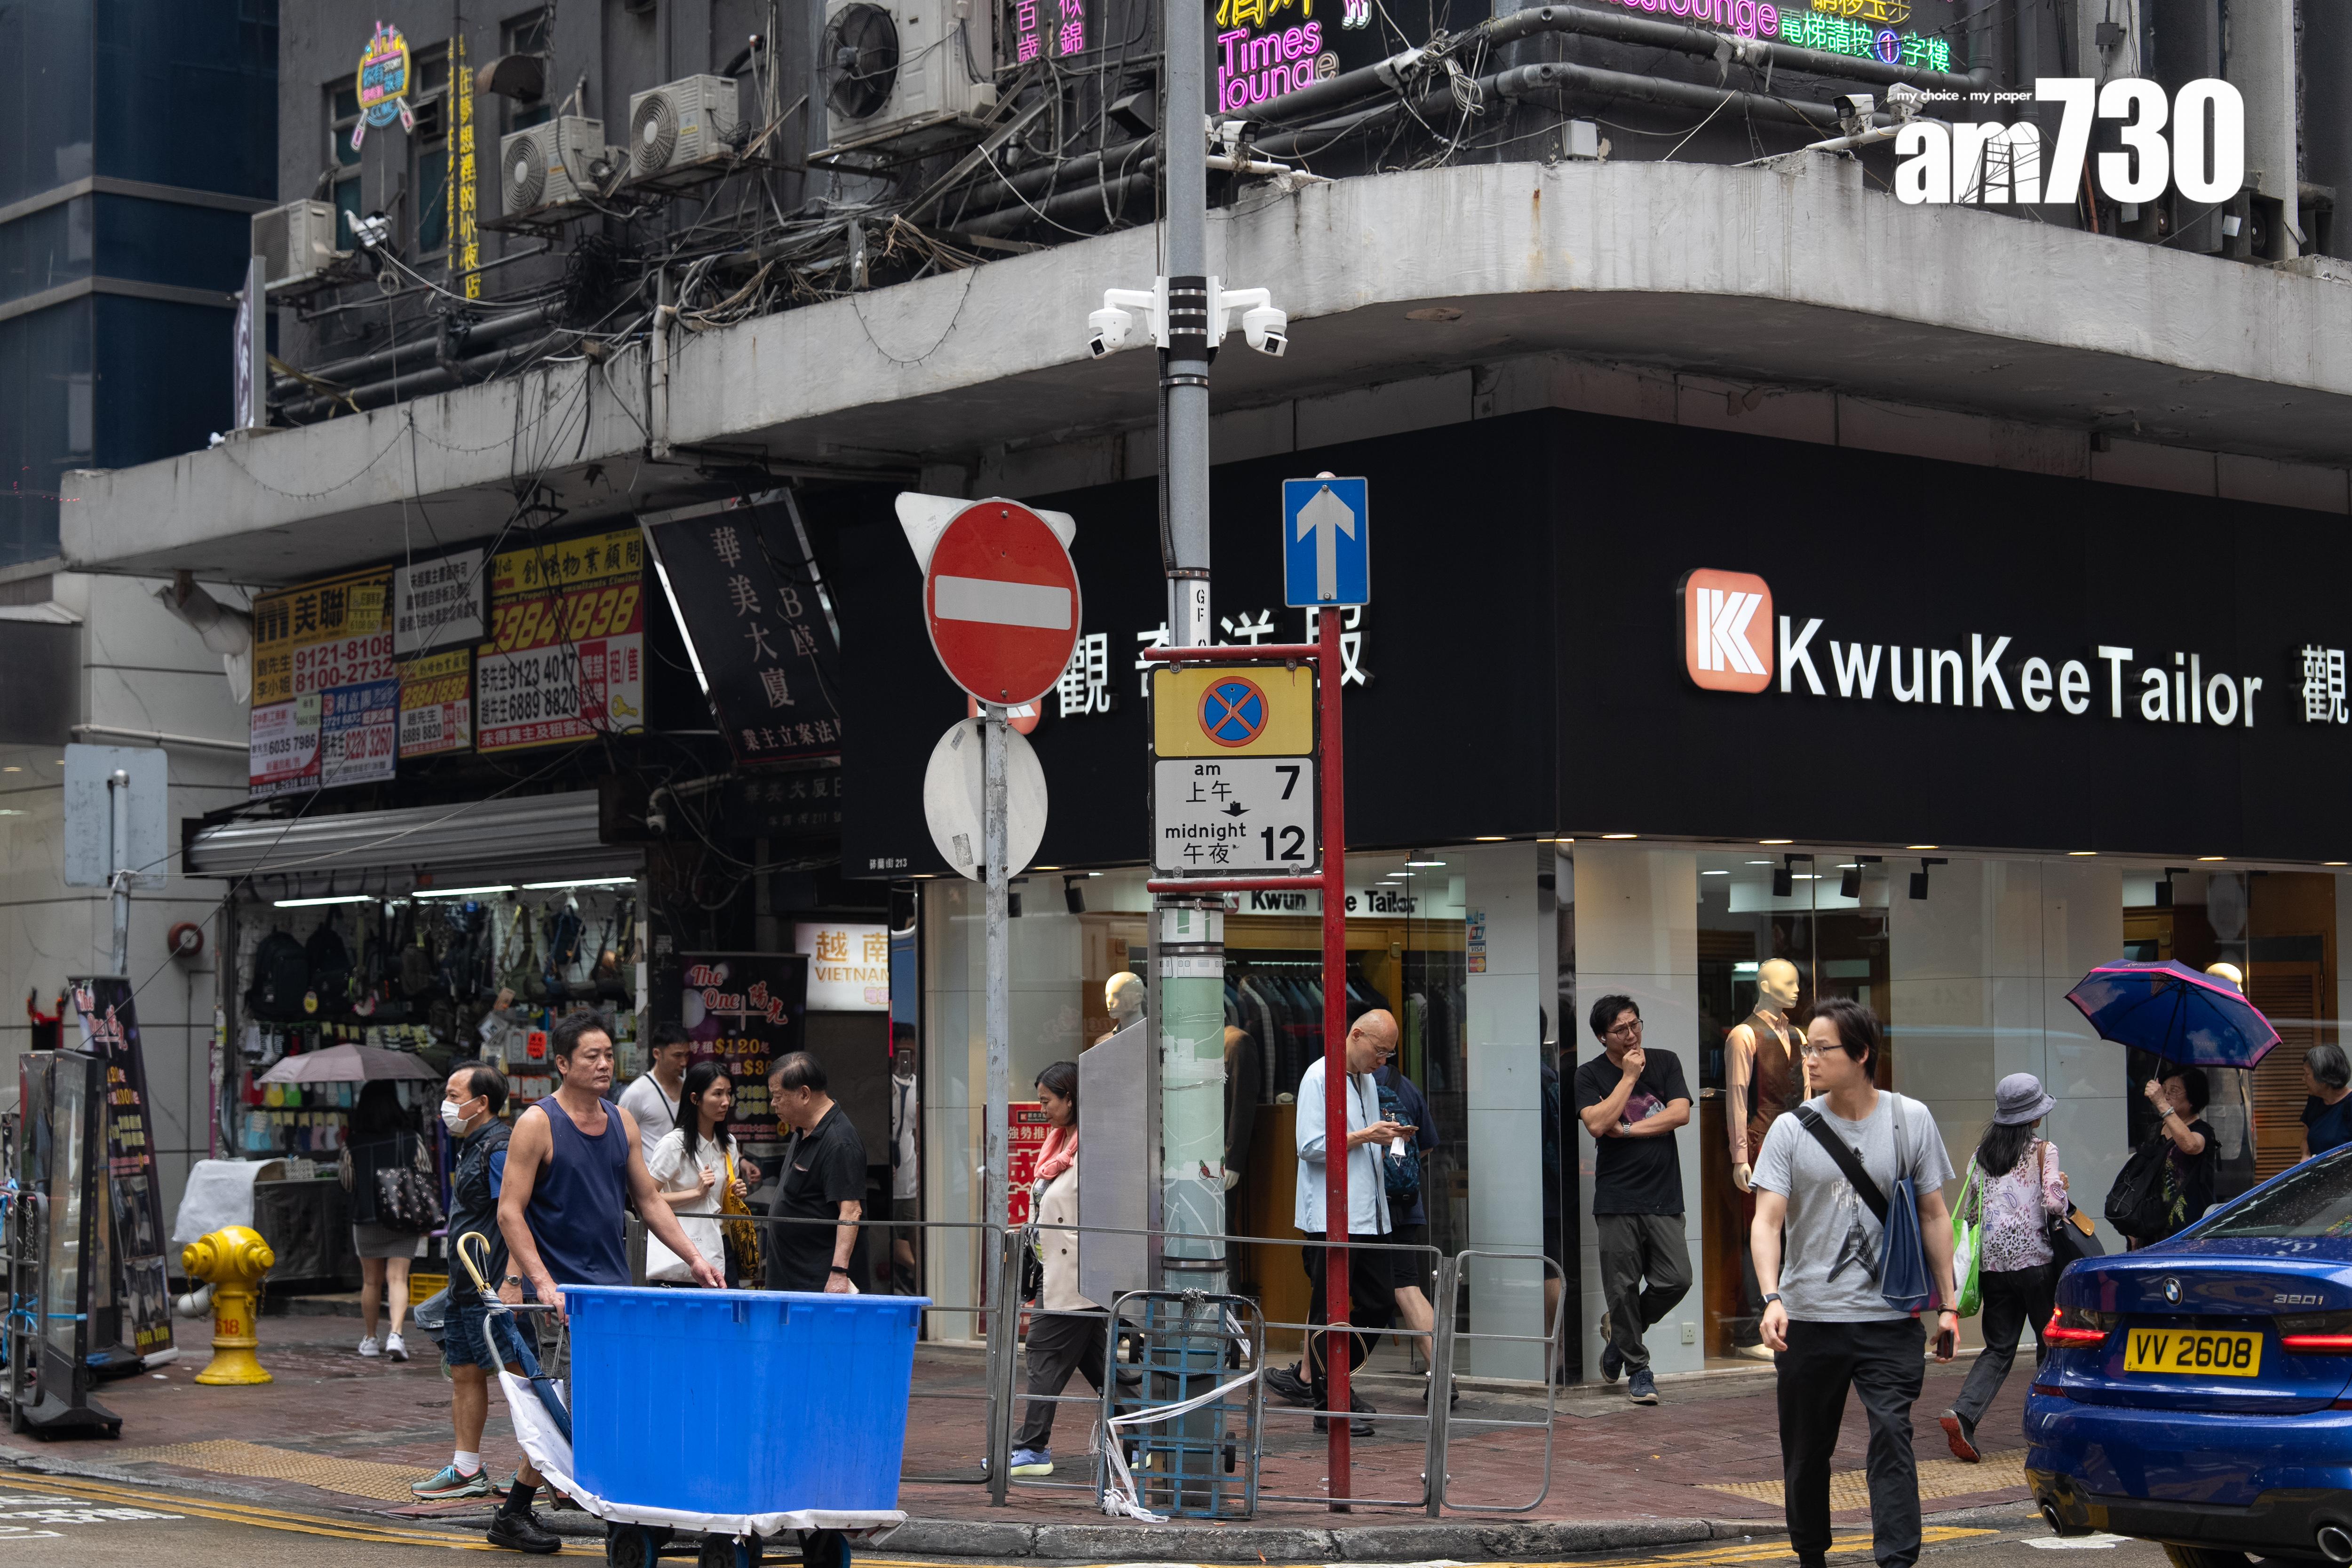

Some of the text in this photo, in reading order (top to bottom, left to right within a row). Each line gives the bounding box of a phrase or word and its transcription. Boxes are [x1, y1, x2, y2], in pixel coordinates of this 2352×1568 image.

[1218, 22, 1321, 77] Times
[1218, 53, 1338, 113] lounge
[710, 526, 795, 708] 華美大廈
[295, 634, 393, 671] 9121-8108
[295, 657, 394, 693] 8100-2732
[509, 657, 540, 689] 9123
[509, 690, 540, 721] 6889
[544, 686, 577, 716] 8820
[269, 738, 291, 754] 6035
[294, 733, 317, 751] 7986
[741, 717, 841, 752] 業主立案法
[1194, 764, 1221, 776] am
[1275, 765, 1300, 800] 7
[1186, 780, 1232, 802] 上午
[1166, 822, 1247, 842] midnight
[1261, 825, 1305, 861] 12
[895, 857, 907, 868] 213
[1184, 842, 1230, 864] 午夜
[1251, 890, 1307, 910] Kwun
[1365, 890, 1418, 913] Tailor
[816, 931, 889, 963] 越南
[690, 964, 723, 987] The
[76, 988, 95, 1012] The
[701, 987, 740, 1009] One
[747, 980, 788, 1025] 陽光
[2274, 1293, 2324, 1306] 320i
[2137, 1334, 2252, 1368] VV 2608
